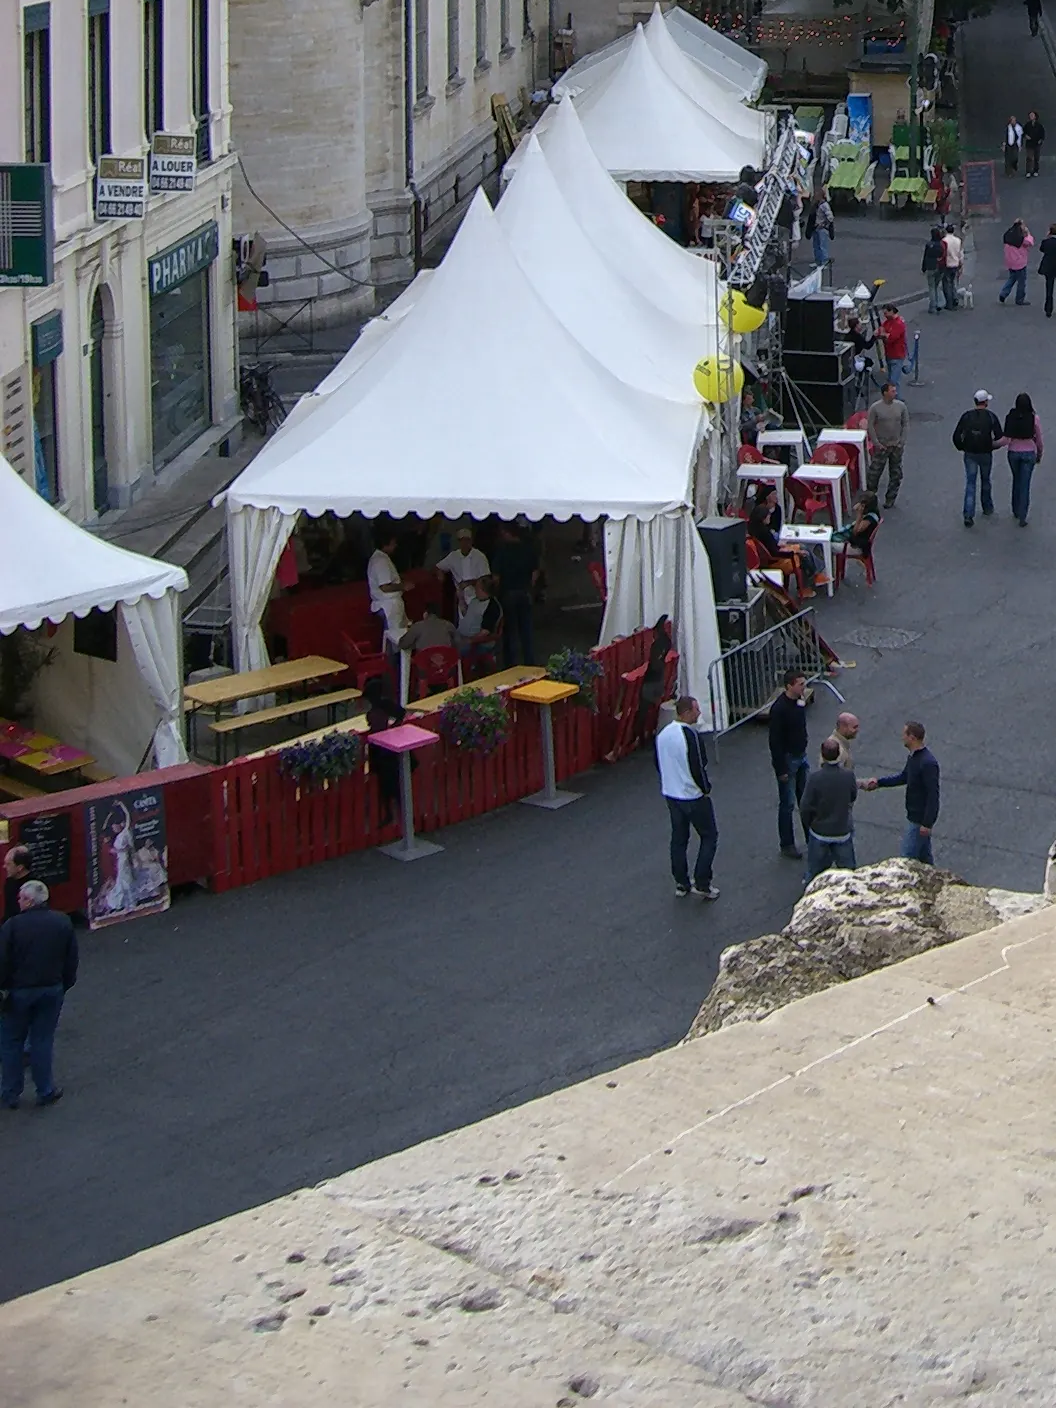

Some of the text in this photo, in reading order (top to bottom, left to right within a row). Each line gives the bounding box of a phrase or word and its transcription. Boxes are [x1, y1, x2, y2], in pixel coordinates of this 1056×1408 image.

[170, 138, 193, 150] Réal
[152, 160, 194, 173] A LOUER
[99, 185, 144, 198] A VENDRE
